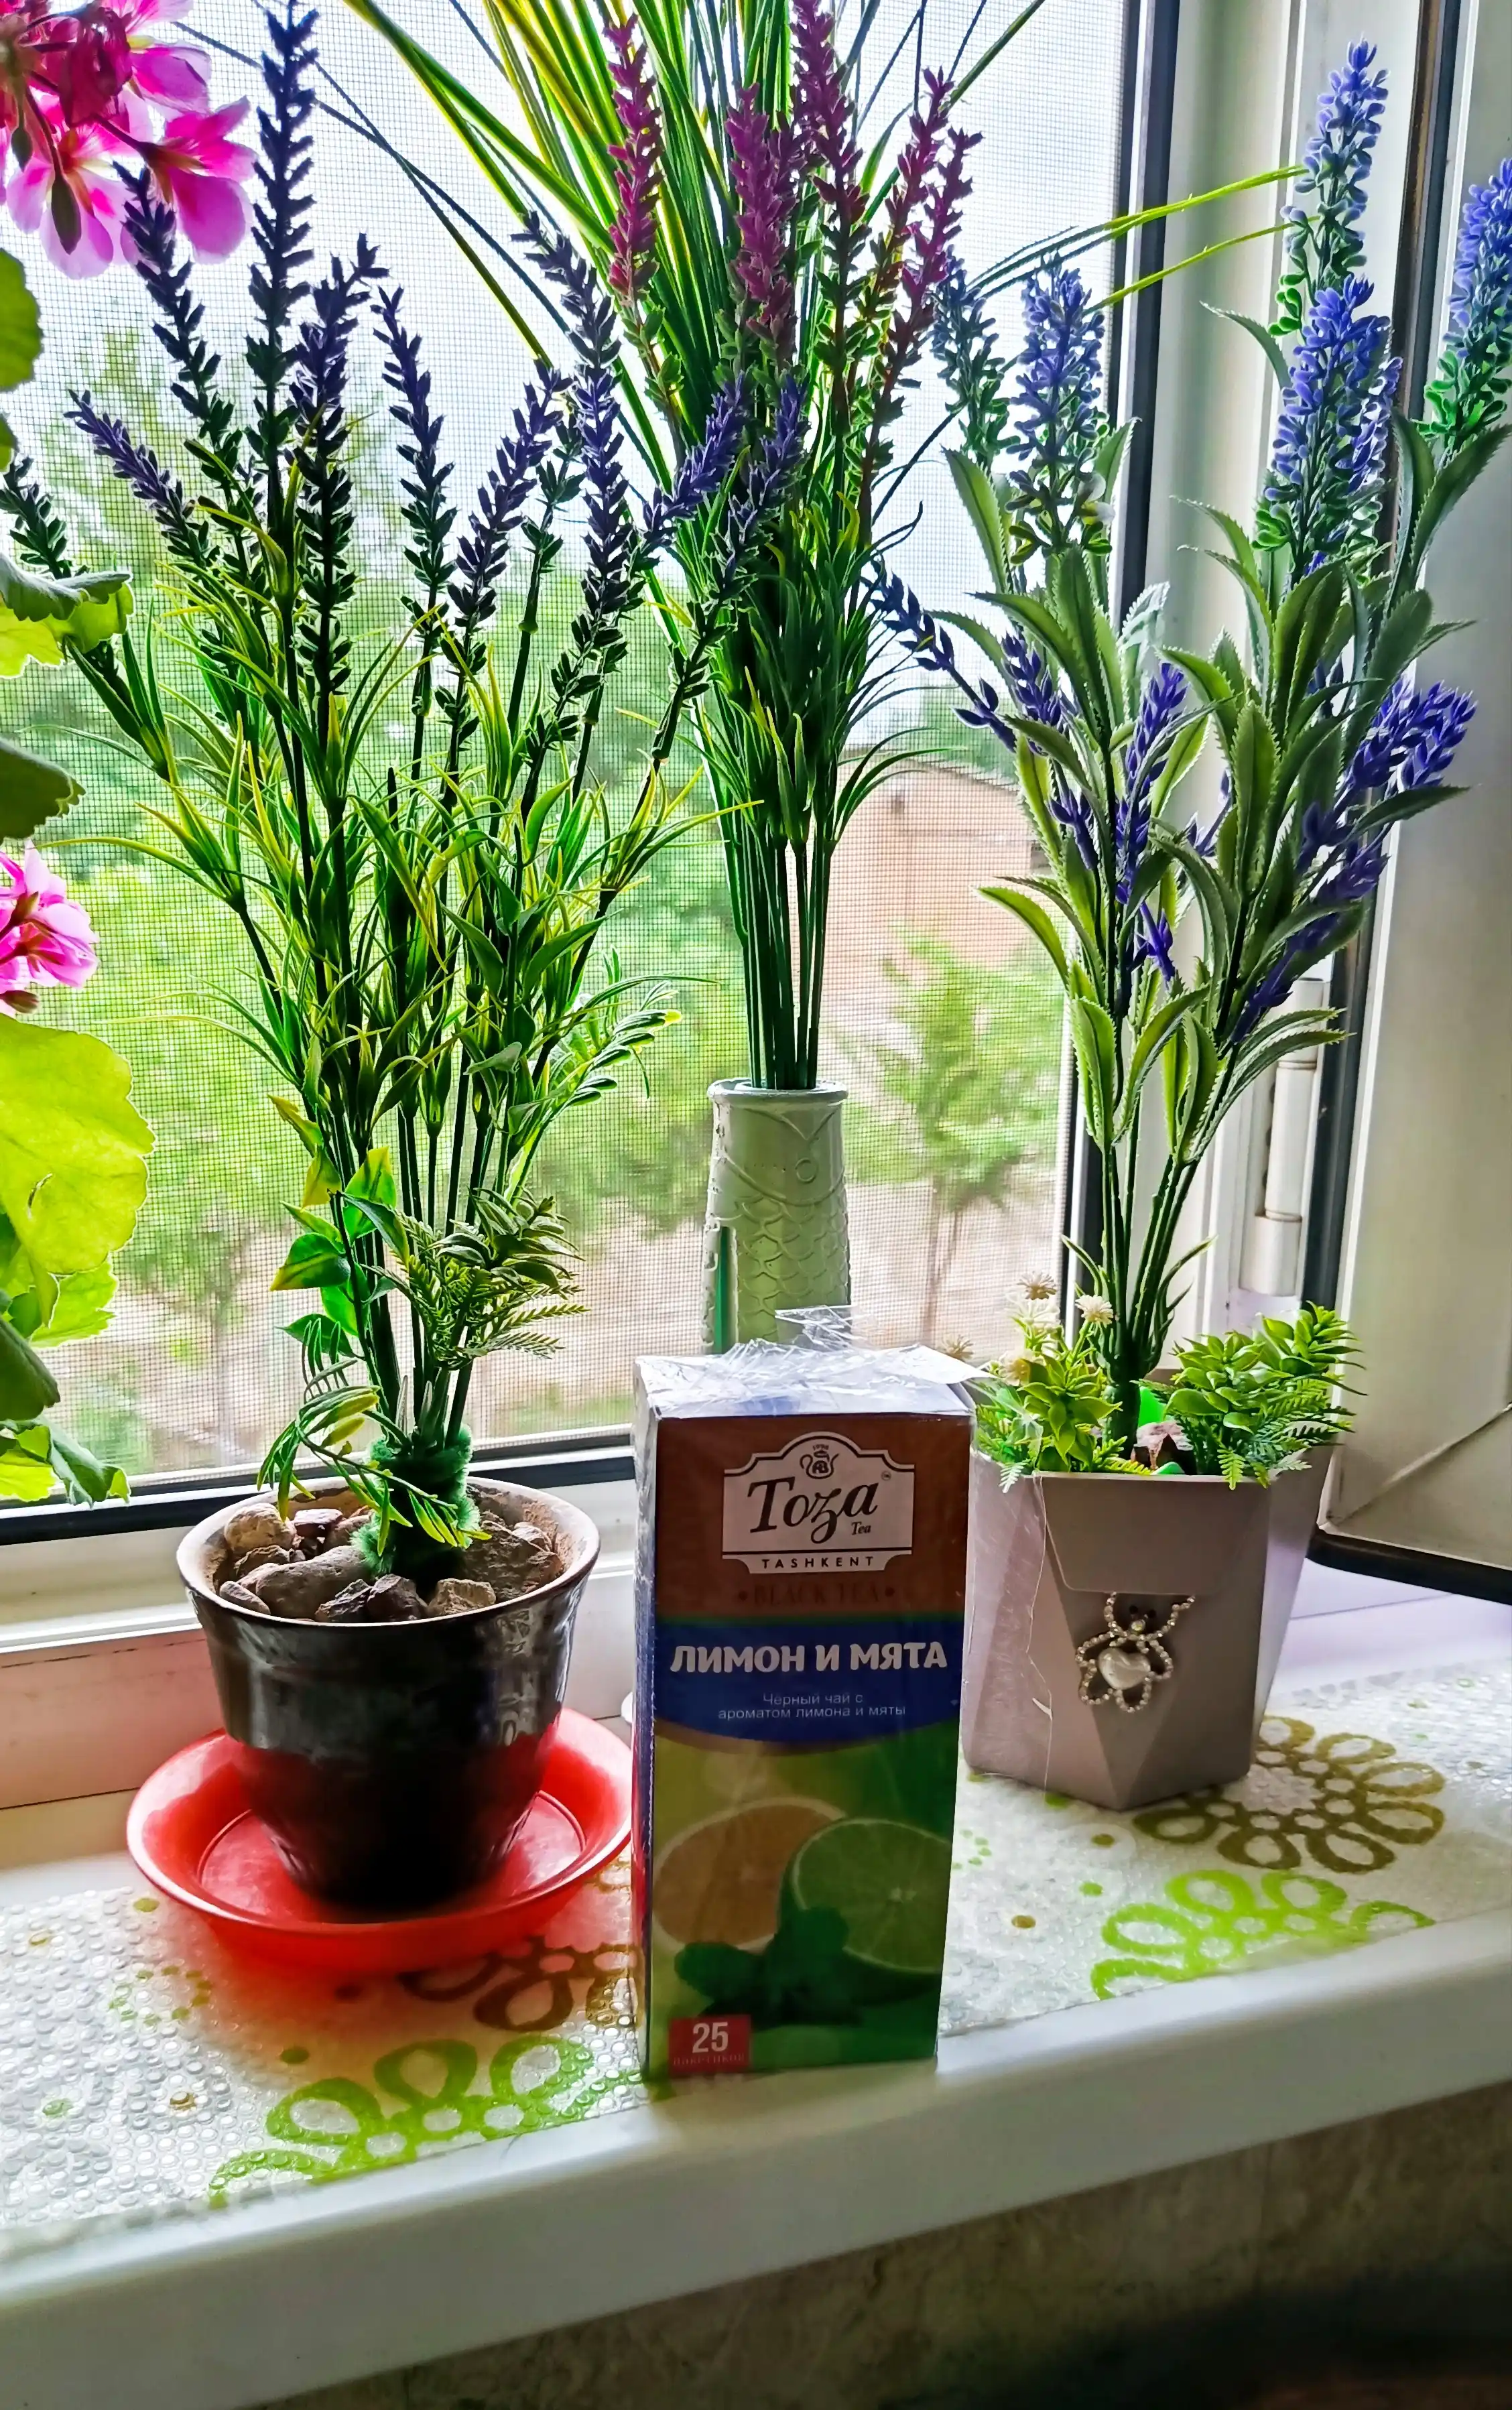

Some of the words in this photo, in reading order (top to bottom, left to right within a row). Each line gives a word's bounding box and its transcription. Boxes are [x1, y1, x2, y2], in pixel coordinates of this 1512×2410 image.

[747, 1476, 879, 1543] Toza
[851, 1521, 871, 1535] Tea
[761, 1556, 874, 1569] TASHKENT
[670, 1645, 805, 1673] ЛИМОН
[816, 1645, 840, 1671] И
[850, 1641, 948, 1671] МЯТА
[825, 1692, 850, 1704] чай
[855, 1694, 864, 1704] с
[718, 1708, 791, 1720] ароматом
[796, 1708, 850, 1718] лимона
[855, 1707, 864, 1716] и
[869, 1706, 905, 1716] мяты
[692, 2021, 729, 2053] 25
